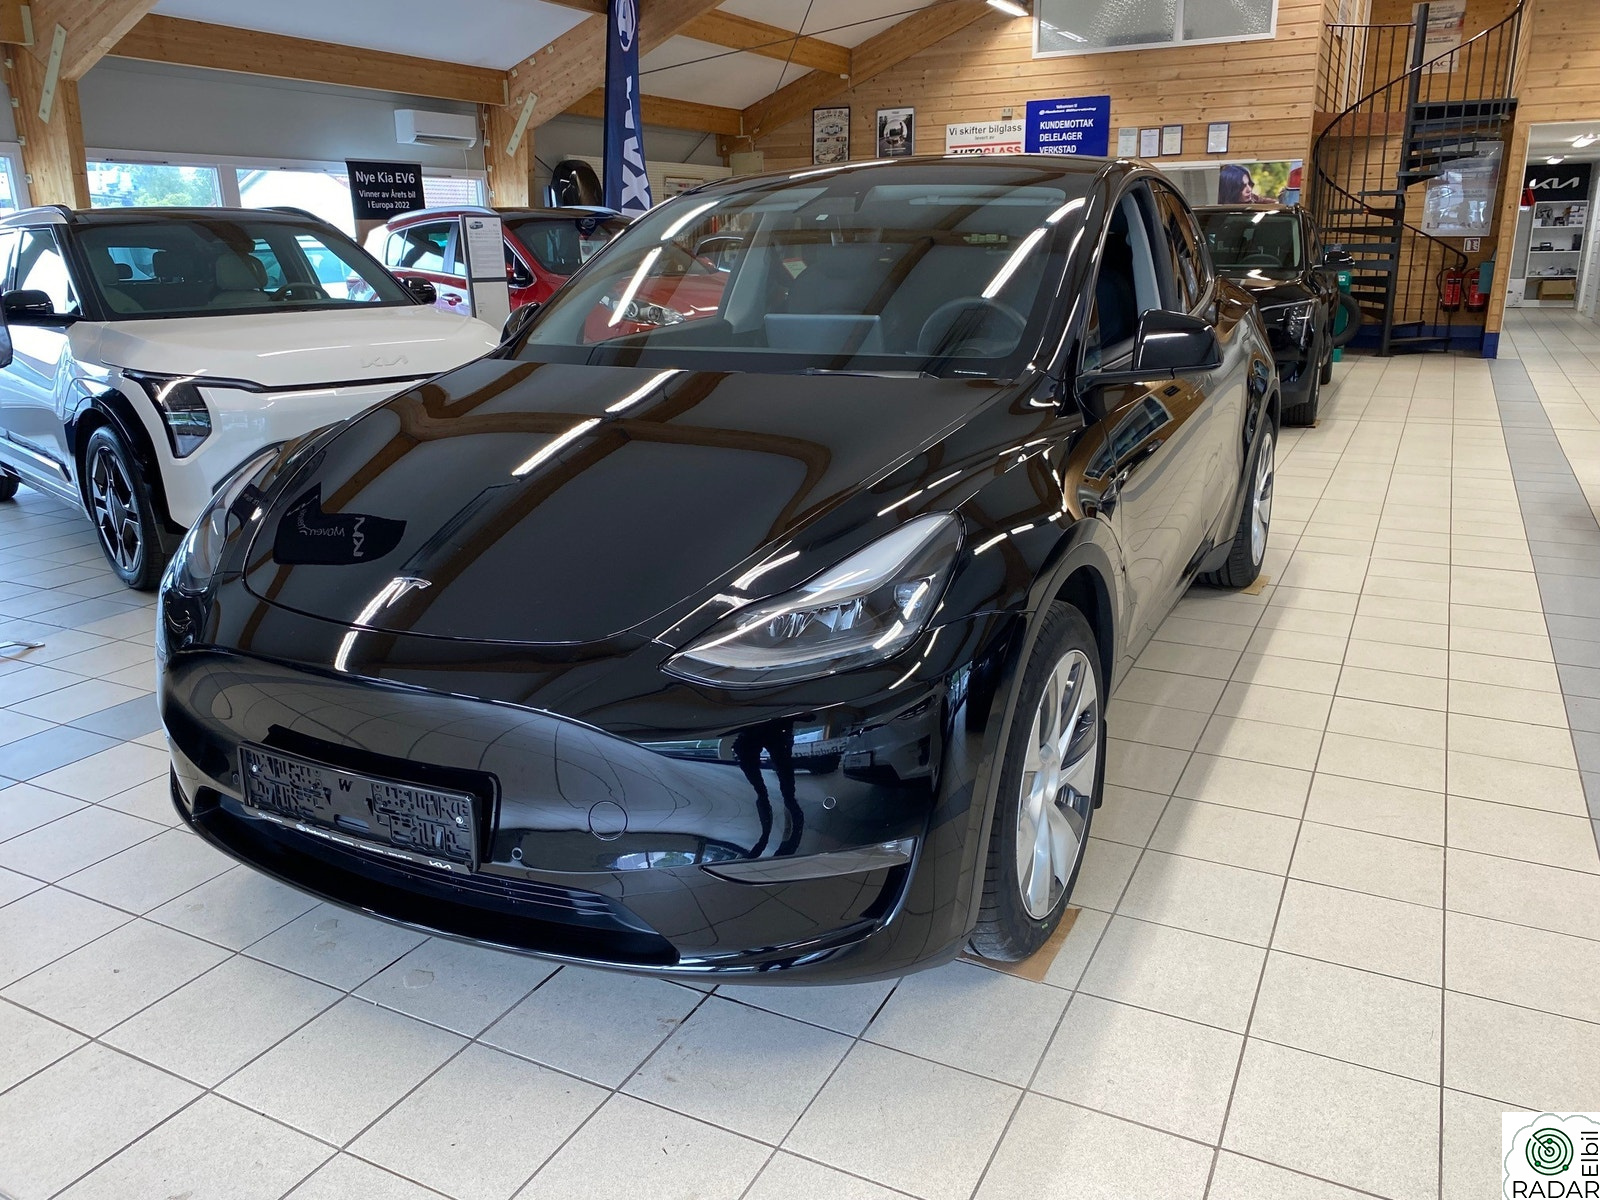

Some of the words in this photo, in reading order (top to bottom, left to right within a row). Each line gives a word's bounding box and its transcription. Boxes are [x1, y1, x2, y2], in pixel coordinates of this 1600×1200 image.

[1040, 119, 1094, 129] KUNDEMOTTAK
[960, 126, 986, 135] skifter
[989, 124, 1022, 134] bilglass
[1039, 132, 1082, 142] DELELAGER
[1039, 145, 1077, 154] VERKSTAD
[355, 171, 376, 185] Nye
[377, 172, 393, 183] Kia
[395, 172, 415, 184] EV6
[1529, 176, 1580, 189] KIA
[359, 189, 380, 198] Vinner
[391, 189, 406, 199] Årets
[407, 190, 416, 198] bil
[371, 201, 394, 210] Europa
[395, 201, 410, 209] 2022
